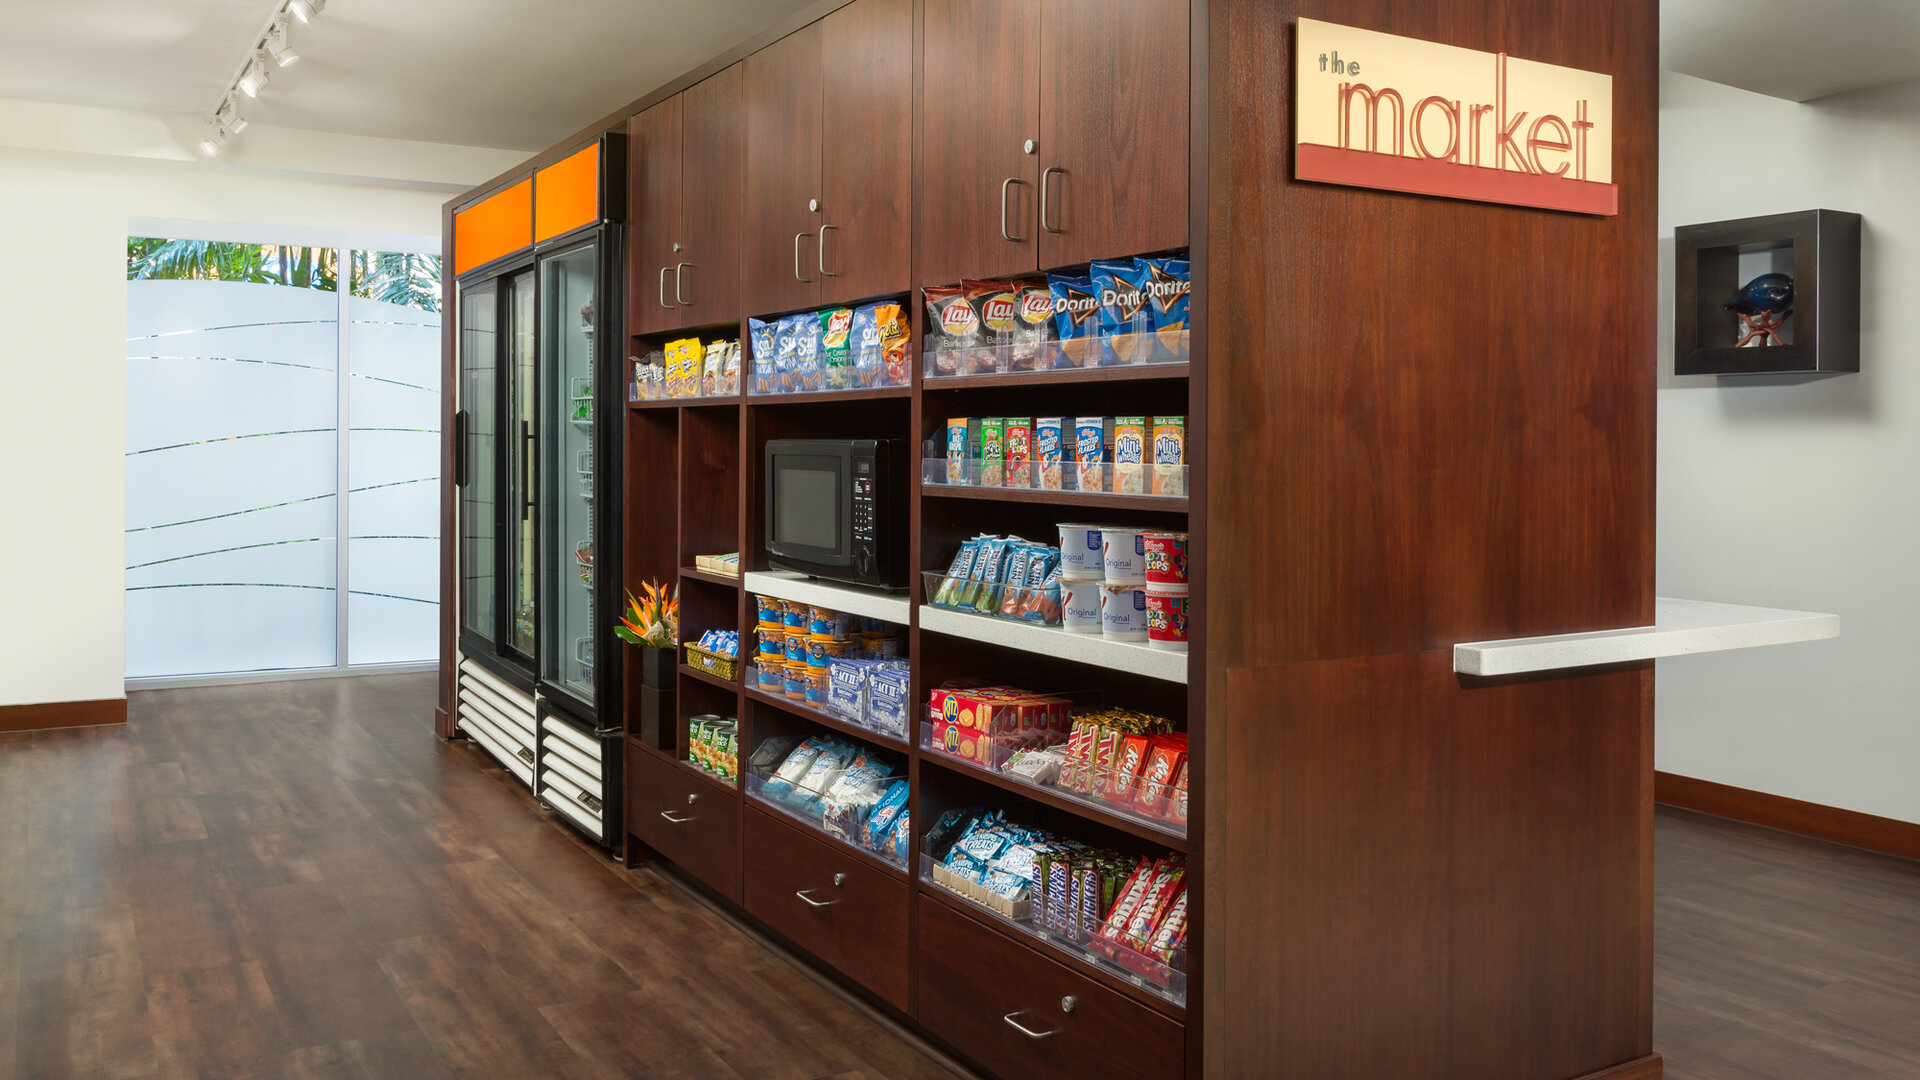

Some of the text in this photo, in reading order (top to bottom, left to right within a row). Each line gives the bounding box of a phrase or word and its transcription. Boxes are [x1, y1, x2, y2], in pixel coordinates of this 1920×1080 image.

[1319, 51, 1361, 76] the
[1338, 52, 1594, 182] market
[1106, 558, 1132, 568] Original
[1067, 607, 1097, 618] Original
[1103, 612, 1130, 623] Original
[838, 671, 849, 682] ACT
[877, 682, 889, 695] ACT
[944, 698, 957, 718] RITZ
[946, 729, 959, 749] RITZ
[1083, 870, 1097, 933] SNICKERS
[1106, 867, 1152, 938] Skittles
[1125, 872, 1171, 941] Skittles
